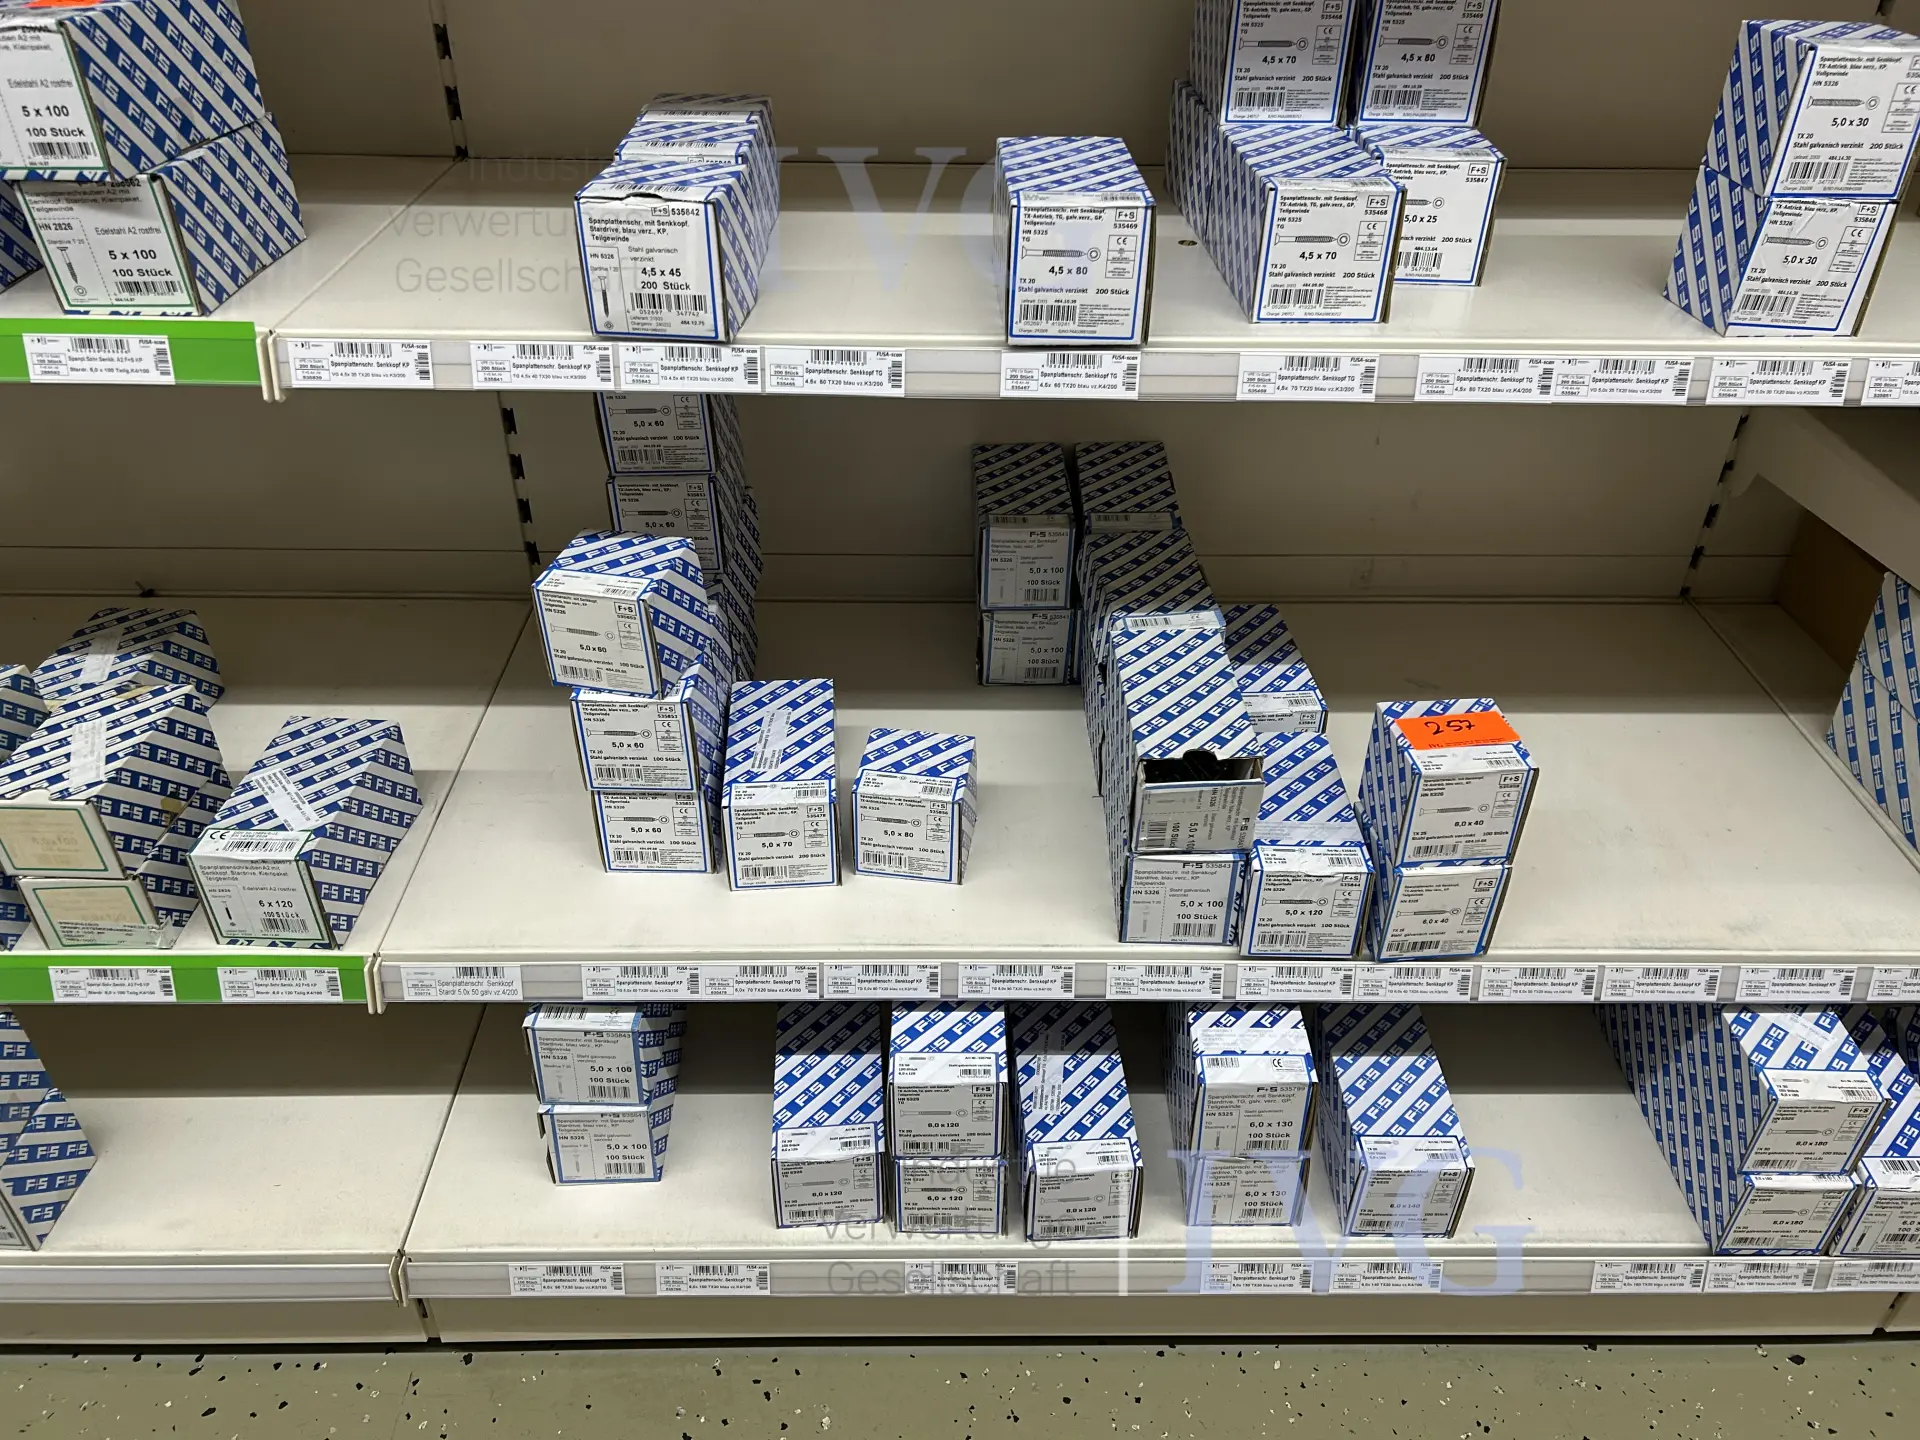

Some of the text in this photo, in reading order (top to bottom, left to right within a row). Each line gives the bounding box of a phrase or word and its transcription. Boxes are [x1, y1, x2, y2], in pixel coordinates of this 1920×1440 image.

[1262, 56, 1275, 65] 4,5
[22, 105, 69, 117] 5 x 100
[1831, 118, 1846, 128] 5,0
[1856, 118, 1869, 127] 30
[26, 127, 85, 136] 100 Stück
[1860, 204, 1876, 213] F+S
[1118, 211, 1134, 219] F+S
[1404, 215, 1417, 224] 5,0
[588, 217, 641, 226] Spanplattenschr.
[95, 227, 127, 235] Edelstahl
[109, 249, 157, 260] 5 x 100
[1299, 251, 1313, 261] 4,5
[1325, 251, 1337, 260] 70
[1782, 255, 1796, 267] 5,0
[1805, 256, 1818, 265] 30
[113, 268, 173, 277] 100 Stück
[669, 268, 681, 276] 45
[1049, 266, 1064, 276] 4,5
[1076, 267, 1088, 275] 80
[641, 281, 691, 290] 200 Stück
[1040, 371, 1083, 379] Spanplattenschr.
[1749, 378, 1792, 386] Spanplattenschr.
[1793, 379, 1817, 387] Senkkopf
[618, 605, 633, 613] F+S
[1424, 719, 1475, 735] 257
[276, 900, 293, 908] 120
[590, 1065, 605, 1073] 5,0
